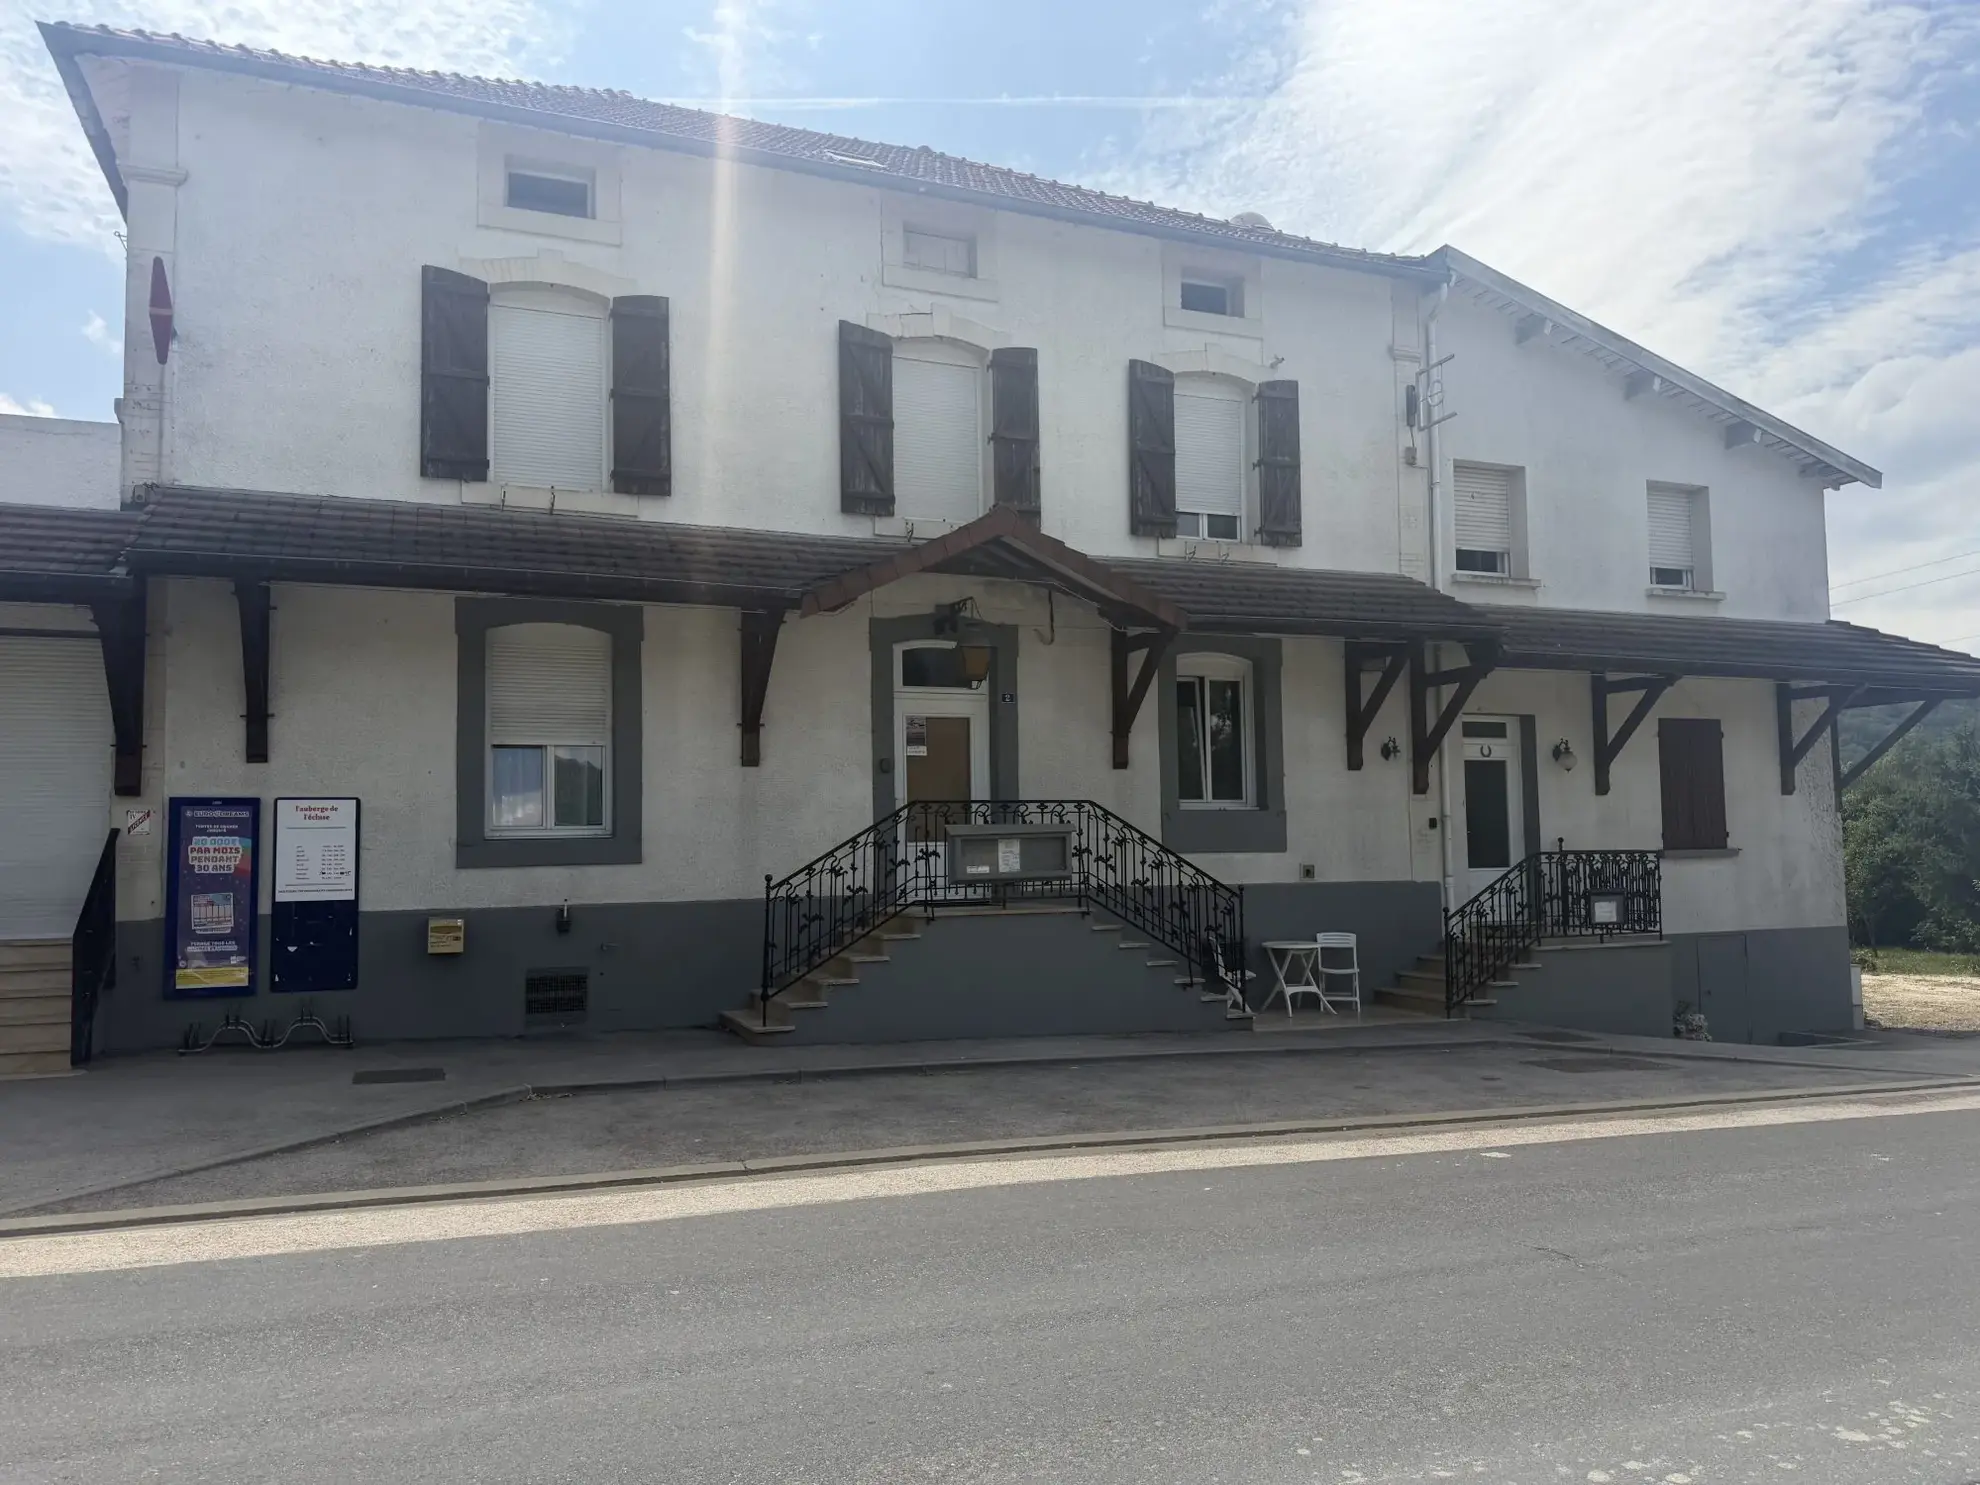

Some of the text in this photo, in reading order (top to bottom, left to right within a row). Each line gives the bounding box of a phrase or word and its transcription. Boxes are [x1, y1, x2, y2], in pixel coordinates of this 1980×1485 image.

[1004, 694, 1011, 702] 2
[190, 846, 241, 854] PAR MOIS
[191, 855, 240, 863] PENDANT
[196, 864, 232, 872] 30 ANS
